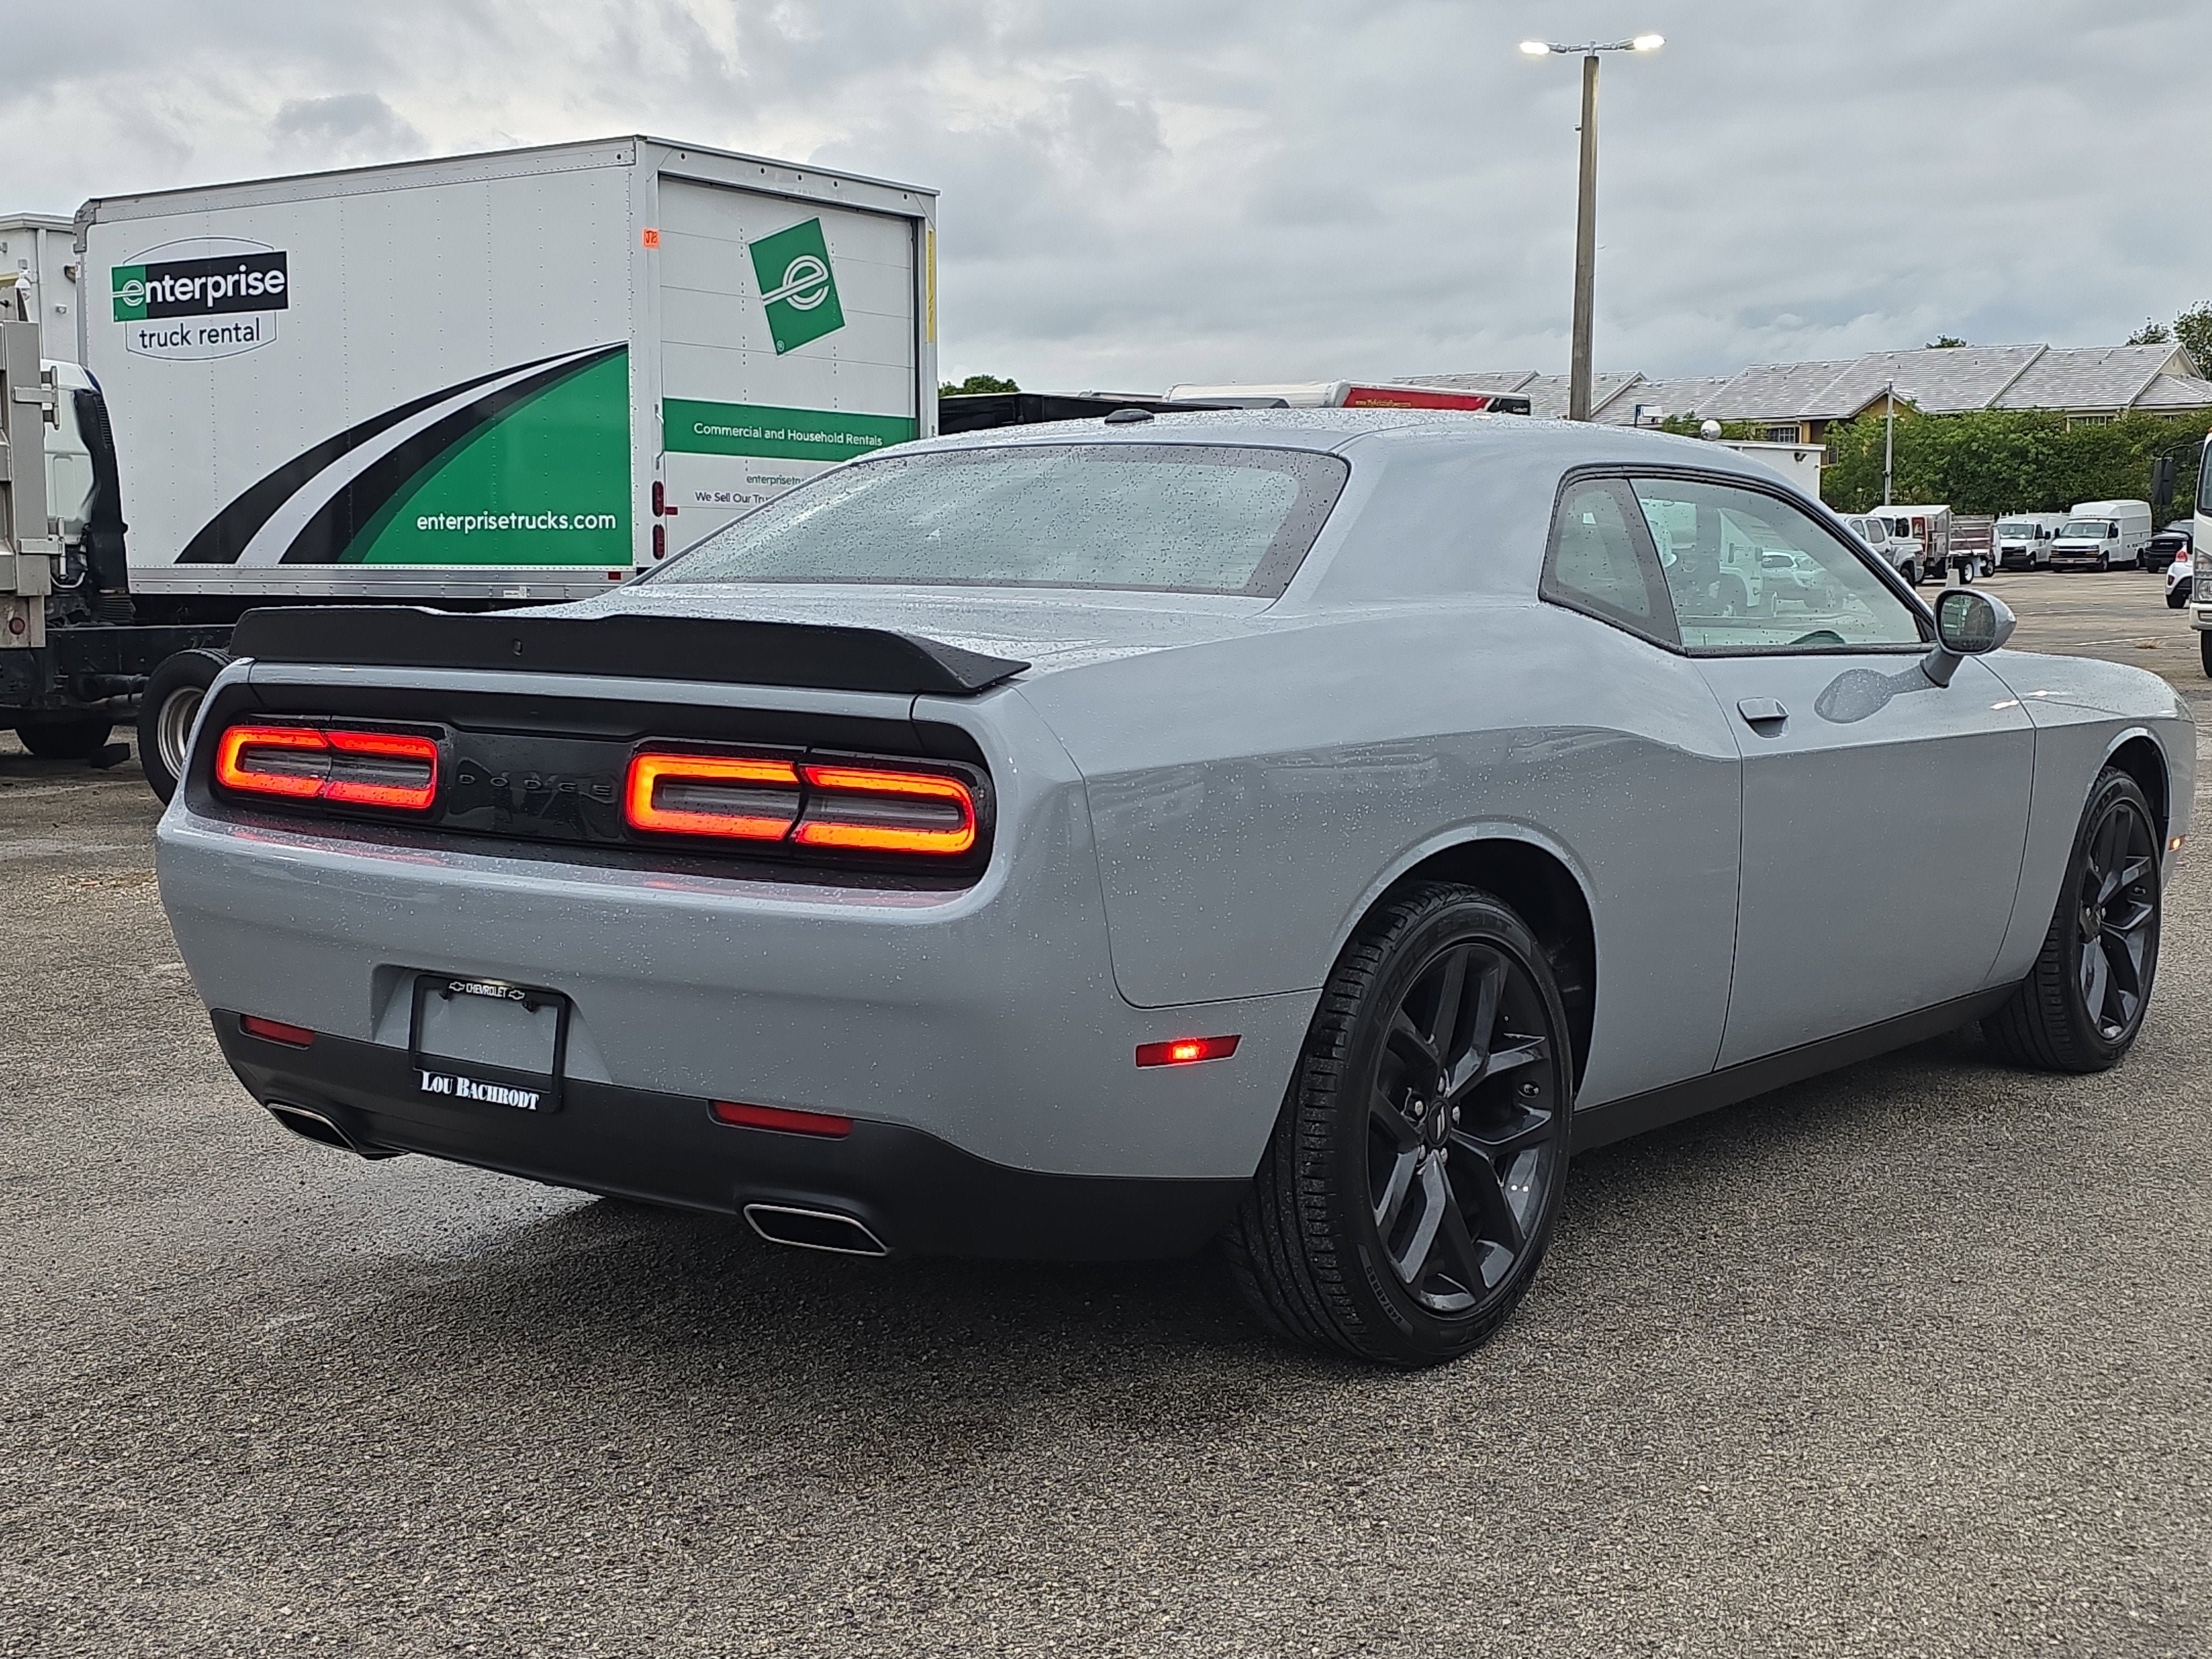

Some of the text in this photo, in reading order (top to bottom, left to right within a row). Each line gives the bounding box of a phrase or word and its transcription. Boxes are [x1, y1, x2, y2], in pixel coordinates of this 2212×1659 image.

[112, 265, 285, 307] enterprise
[139, 318, 260, 349] truck rental
[693, 422, 883, 446] Commercial and Household Rentals
[695, 491, 712, 501] We
[714, 492, 730, 502] Sell
[732, 493, 751, 503] Our
[416, 511, 616, 534] enterprisetrucks.com
[459, 774, 612, 796] DODGE
[466, 983, 509, 998] CHEVROLET
